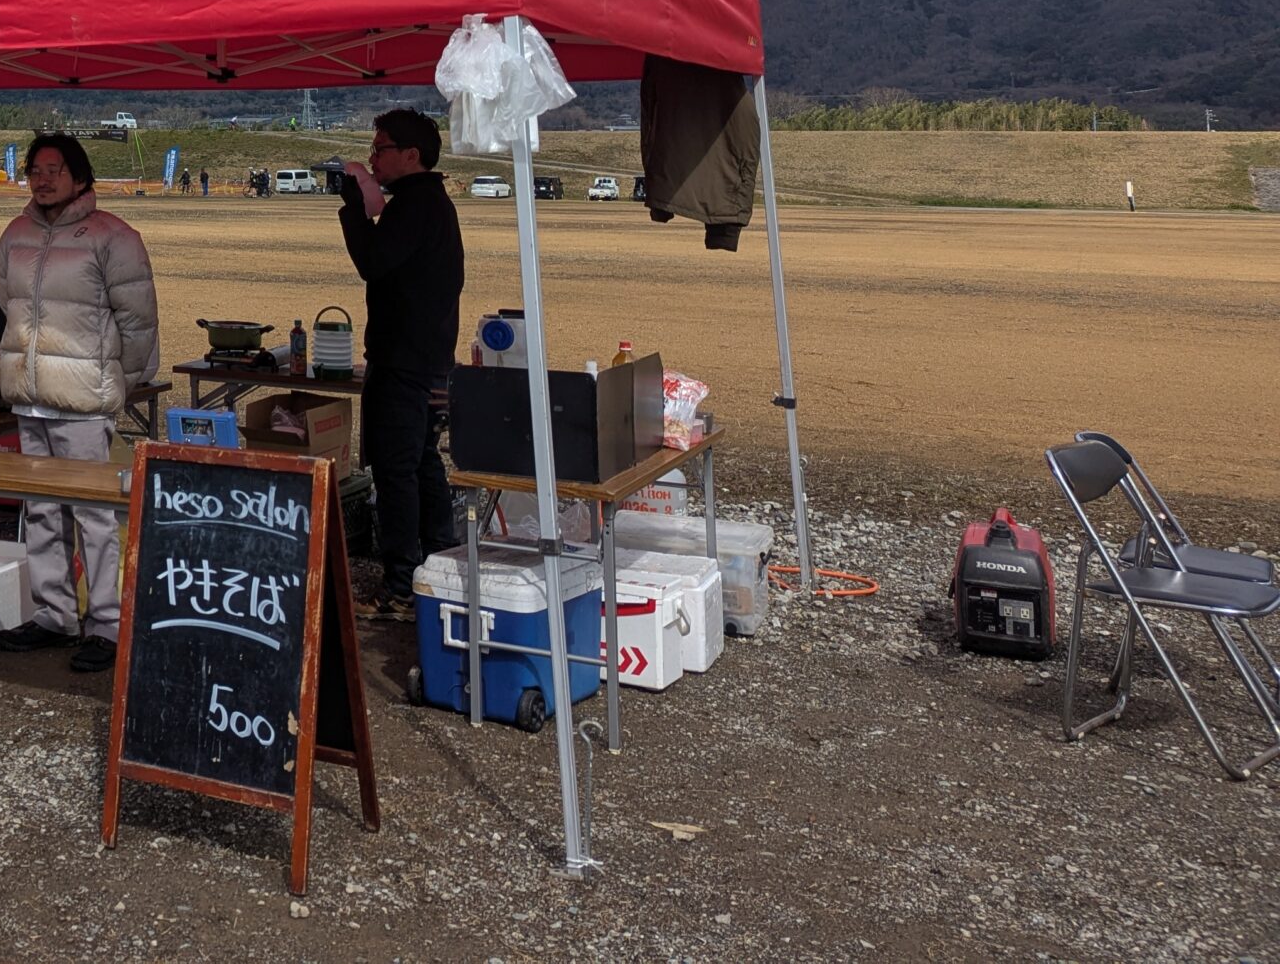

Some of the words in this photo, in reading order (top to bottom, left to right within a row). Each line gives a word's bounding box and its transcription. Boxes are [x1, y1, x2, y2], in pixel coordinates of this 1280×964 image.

[154, 473, 224, 518] heso
[230, 485, 310, 534] salon
[156, 557, 300, 626] やきそば
[976, 561, 1027, 574] HONDA
[208, 683, 275, 747] 500
